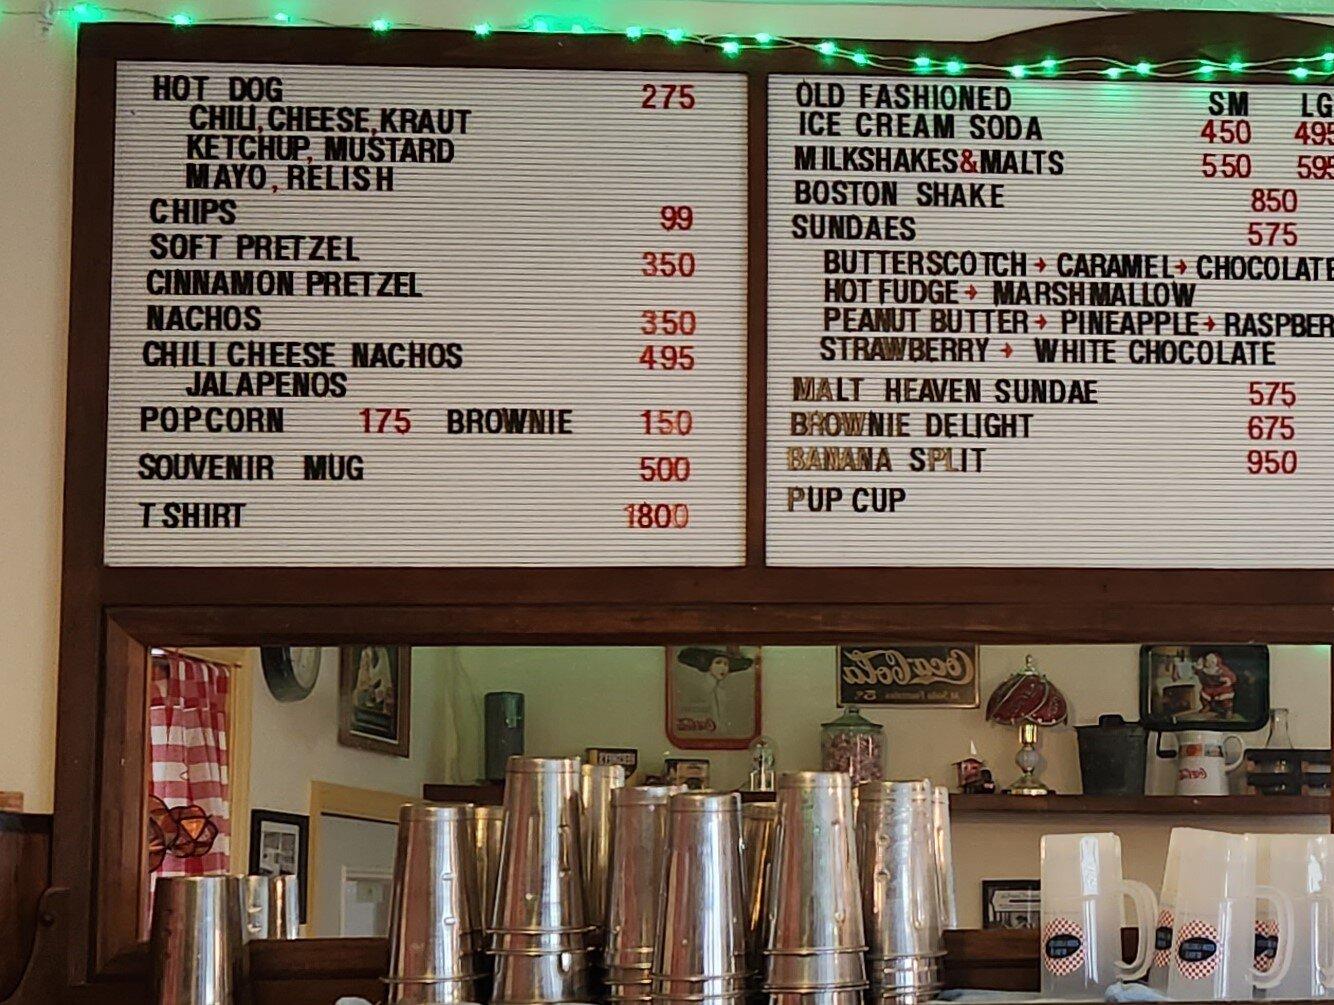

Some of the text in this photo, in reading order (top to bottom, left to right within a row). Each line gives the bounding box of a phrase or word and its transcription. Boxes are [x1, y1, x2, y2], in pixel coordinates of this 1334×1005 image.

[153, 75, 695, 110] HOT DOG 275
[797, 82, 1333, 117] OLD FASHIONED SM LG
[800, 112, 840, 140] ICE
[856, 112, 954, 140] CREAM
[970, 112, 1042, 140] SODA
[1202, 120, 1251, 146] 450
[1202, 154, 1251, 180] 550
[796, 181, 1297, 213] BOSTON SHAKE 850
[150, 200, 693, 231] CHIPS 99
[792, 215, 1297, 246] SUNDAES 575
[150, 235, 695, 278] SOFT PRETZEL 350
[824, 250, 1027, 280] BUTTERSCOTCH
[1057, 250, 1174, 280] CARAMEL
[147, 270, 422, 297] CINNAMON PRETZEL
[824, 279, 1196, 303] HOT FUDGE MARSHMALLOW
[147, 306, 696, 335] NACHOS 350
[824, 308, 916, 338] PEANUT
[931, 308, 1028, 338] BUTTER
[1062, 308, 1198, 338] PINEAPPLE
[143, 341, 695, 370] CHILI CHEESE NACHOS 495
[821, 338, 1275, 365] STRAWBERRY WHITE CHOCOLATE
[186, 372, 347, 397] JALAPENOS
[140, 407, 692, 434] POPCORN 175 BROWNIE 150
[791, 412, 1295, 440] BROWNIE DELIGHT 675
[139, 454, 690, 481] SOUVENIR MUG 500
[788, 487, 906, 512] PUP CUP
